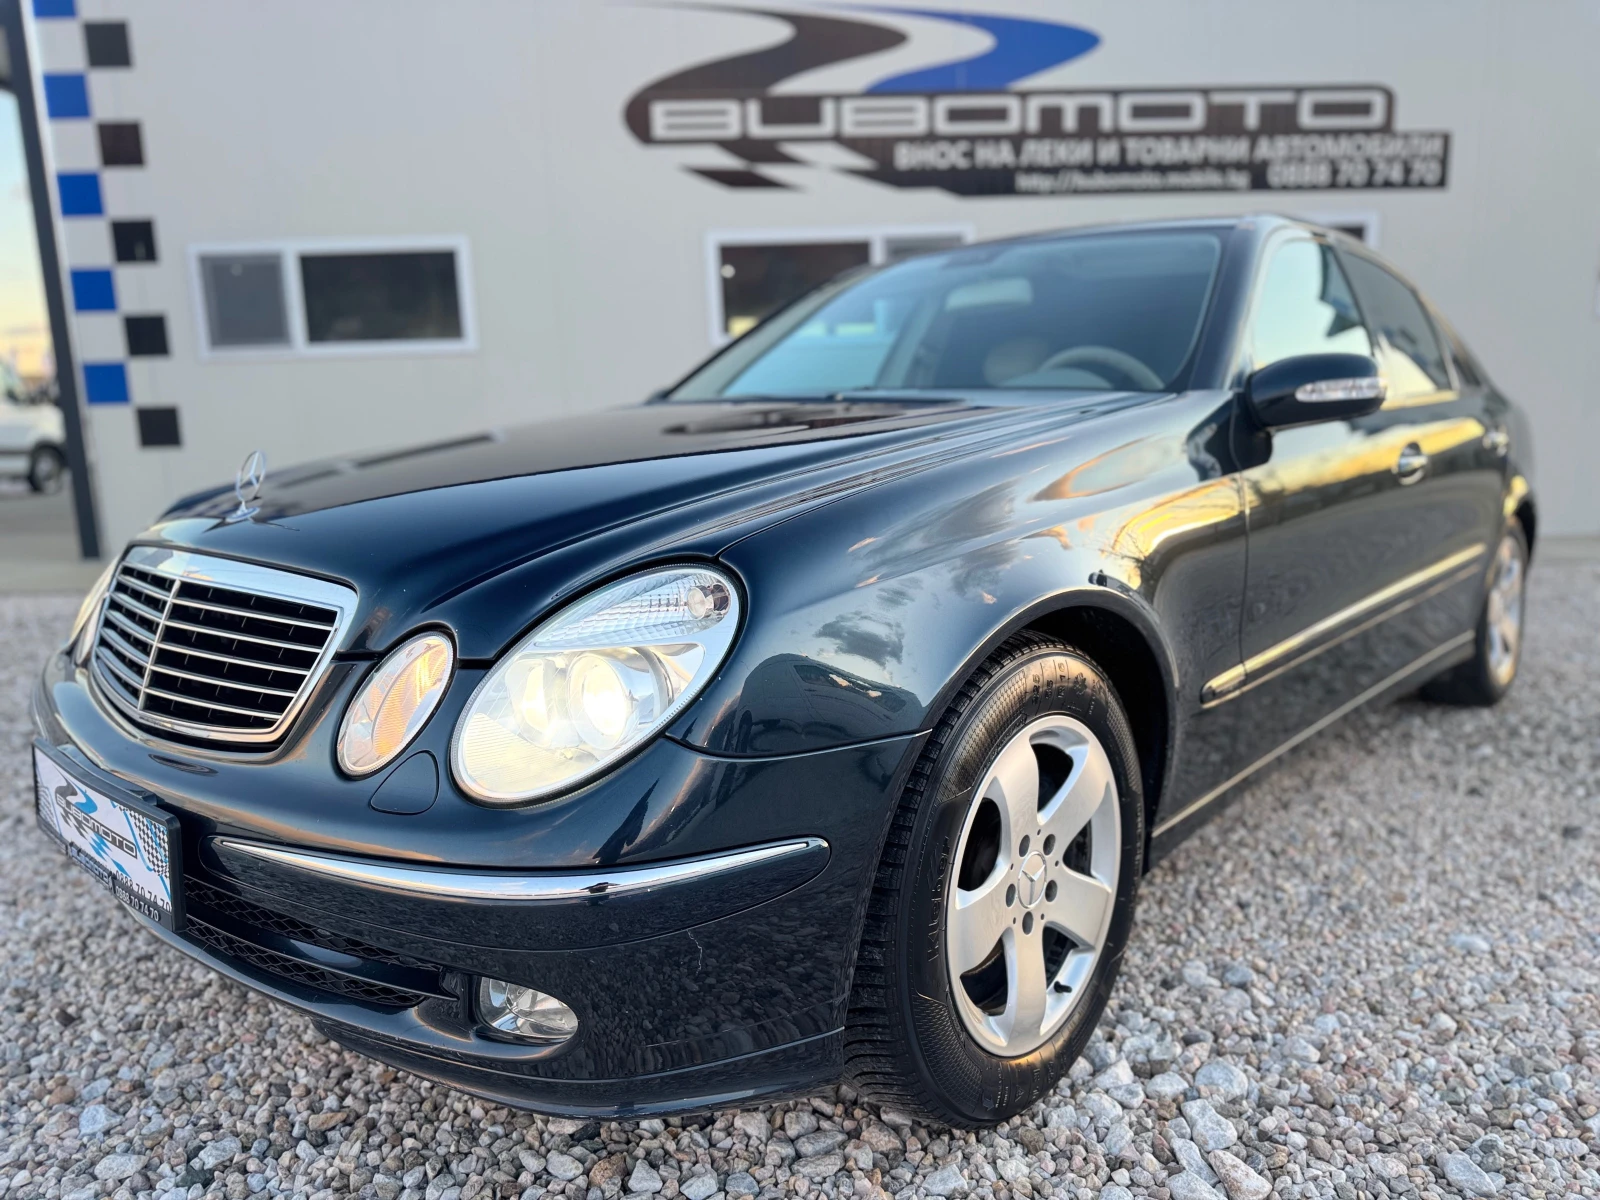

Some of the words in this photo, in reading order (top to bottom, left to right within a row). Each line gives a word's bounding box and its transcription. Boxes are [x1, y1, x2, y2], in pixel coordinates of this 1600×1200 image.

[649, 90, 1387, 140] BUBOMOTO
[893, 140, 971, 171] ВНОС
[974, 140, 1017, 169] НА
[1018, 138, 1093, 168] ЛЕКИ
[1096, 138, 1121, 166] И
[1123, 134, 1250, 166] ТОВАРНИ
[1253, 132, 1446, 163] АВТОМОБИЛИ
[1266, 159, 1333, 188] 0888
[1335, 159, 1370, 187] 70
[1371, 158, 1405, 186] 74
[1407, 158, 1443, 186] 70
[56, 793, 136, 857] BUBOMOTO
